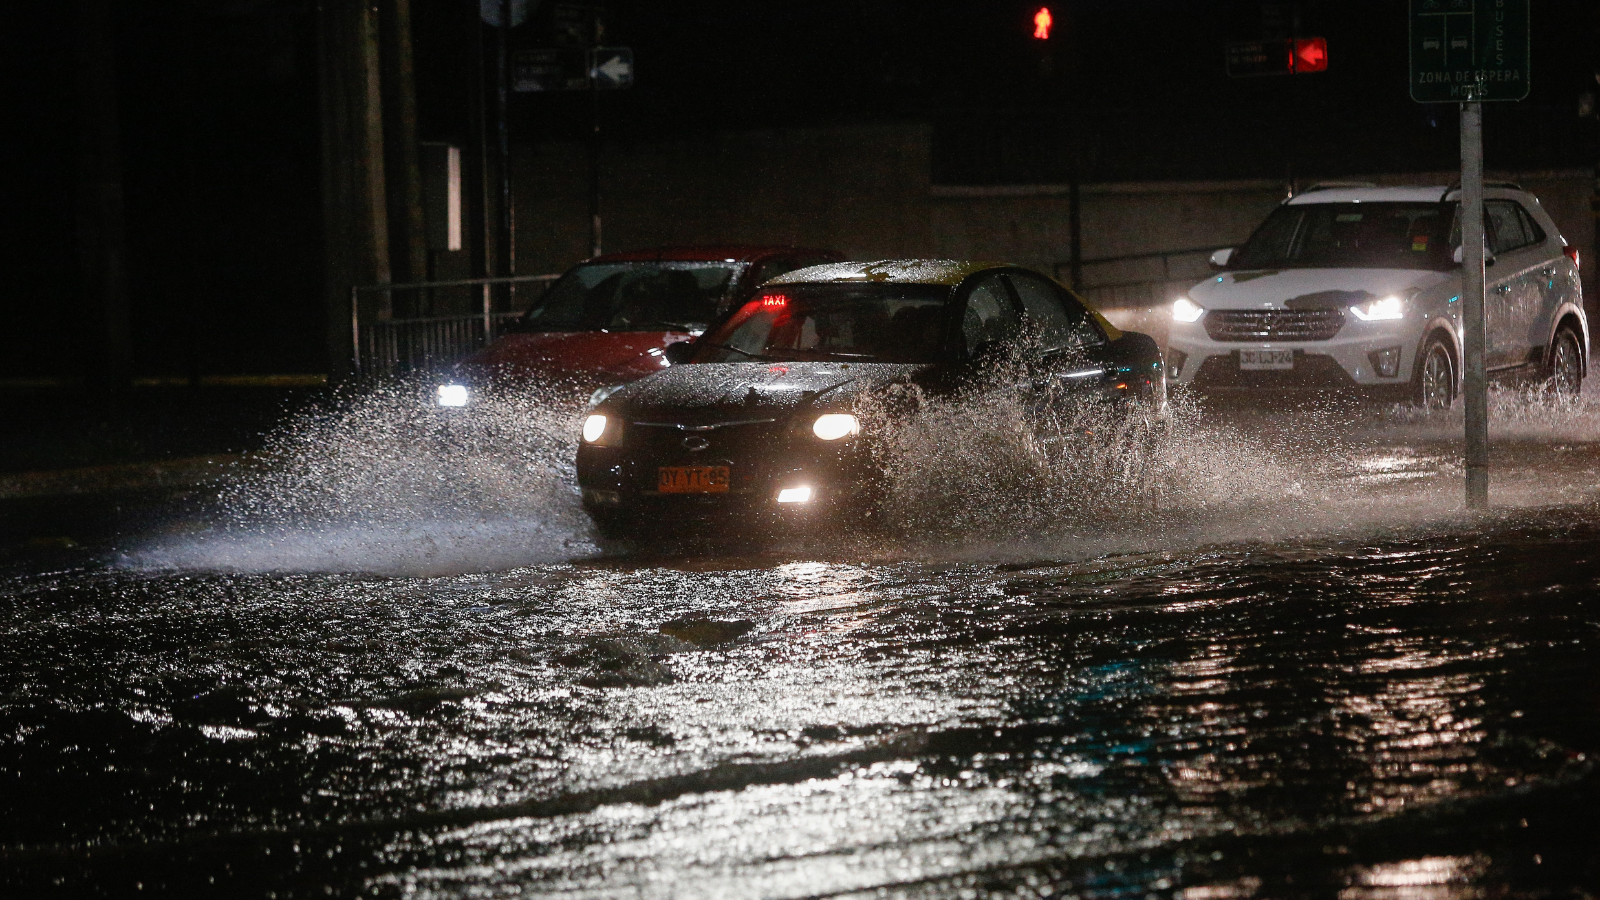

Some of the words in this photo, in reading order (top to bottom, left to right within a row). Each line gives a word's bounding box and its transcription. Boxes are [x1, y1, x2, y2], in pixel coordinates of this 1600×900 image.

[1495, 0, 1504, 65] BUSES
[1419, 72, 1452, 84] ZONA
[1455, 71, 1470, 82] DE
[1474, 69, 1520, 82] ESPERA
[763, 295, 786, 306] TAXI
